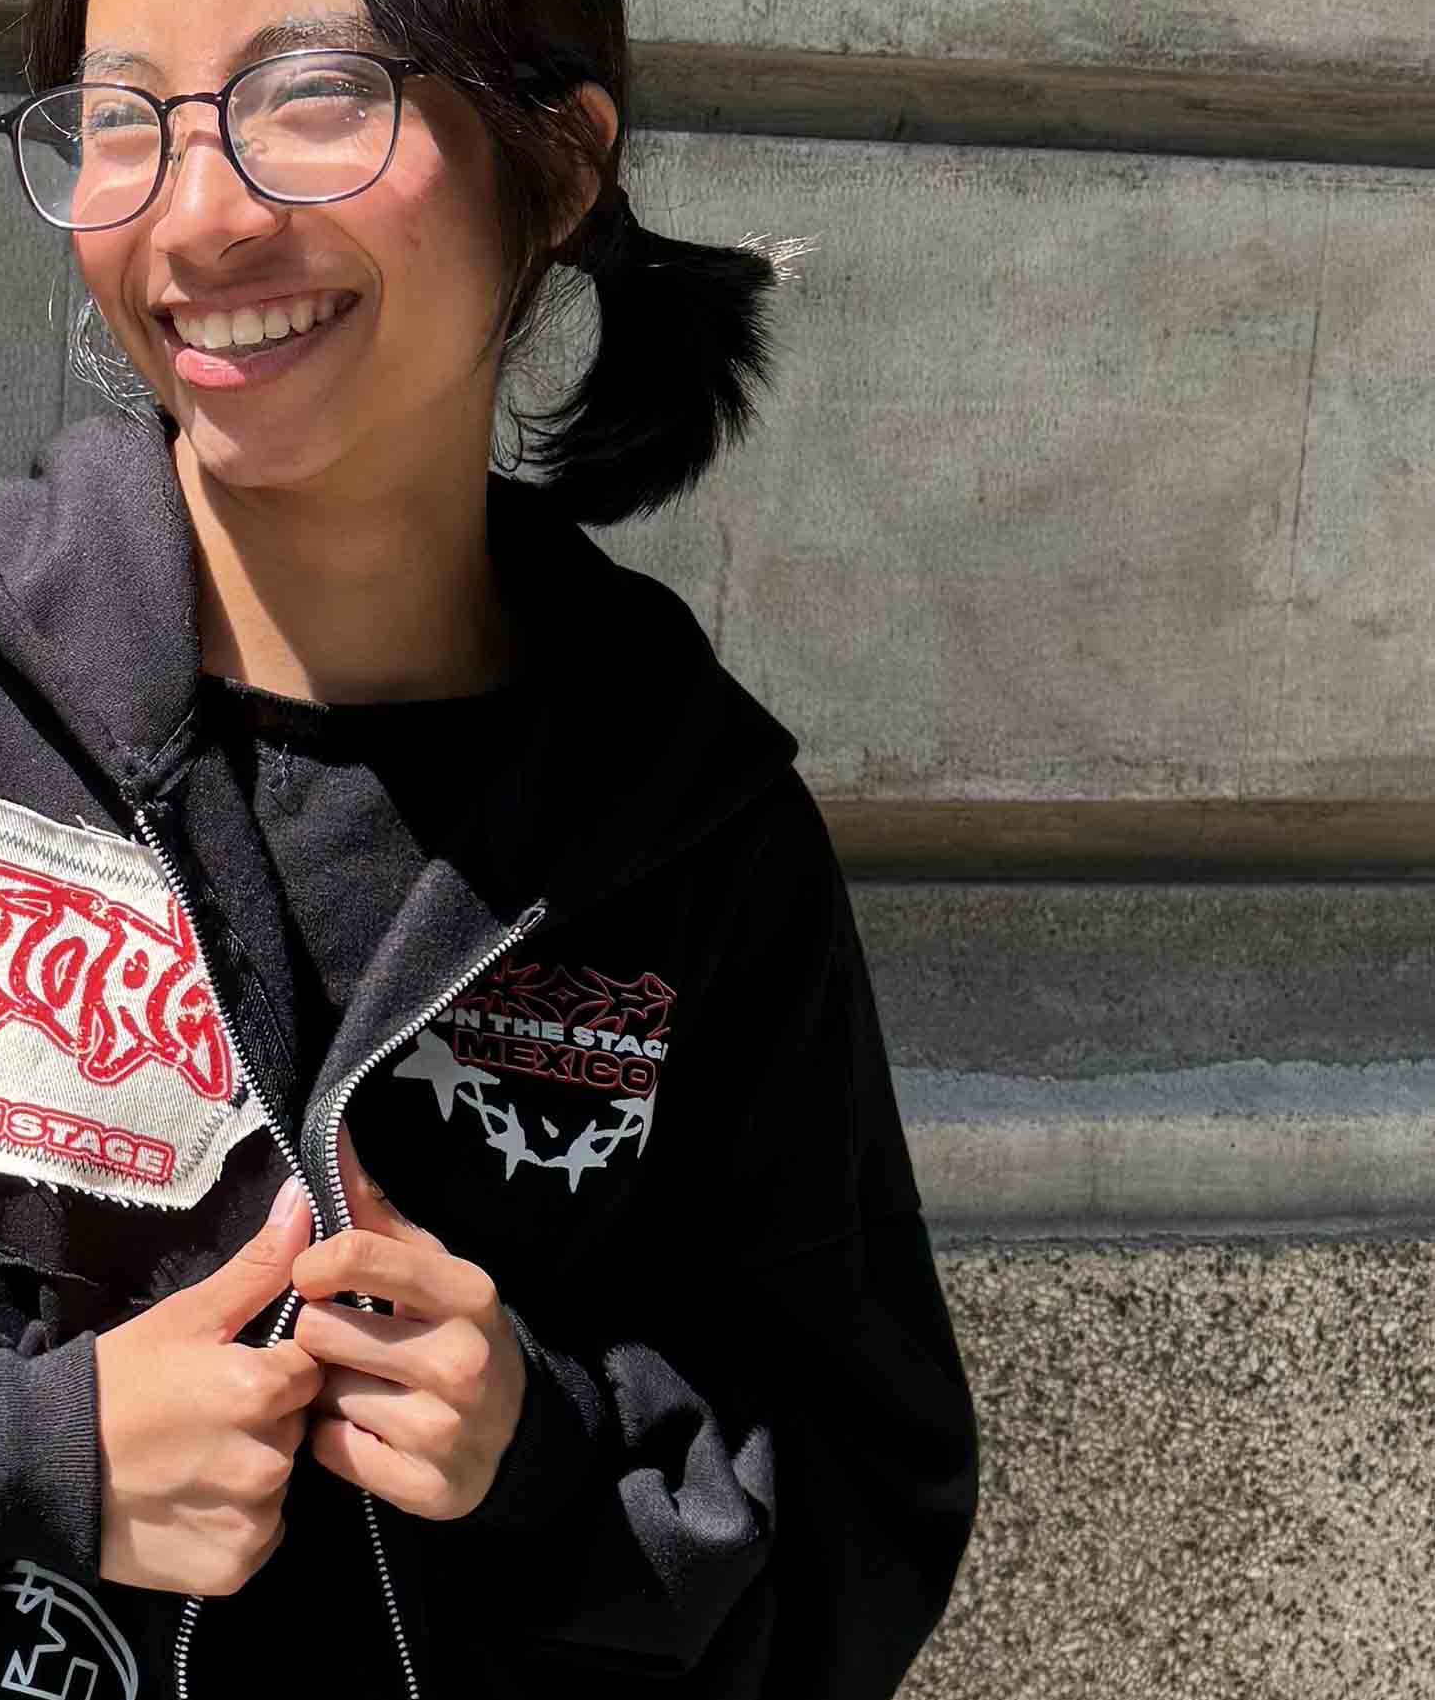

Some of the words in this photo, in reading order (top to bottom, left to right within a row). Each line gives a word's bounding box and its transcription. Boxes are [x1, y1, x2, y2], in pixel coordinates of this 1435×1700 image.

[453, 1027, 657, 1095] MEXICO
[487, 1013, 565, 1042] THE
[572, 1025, 669, 1062] STAG
[7, 1110, 169, 1176] STAGE
